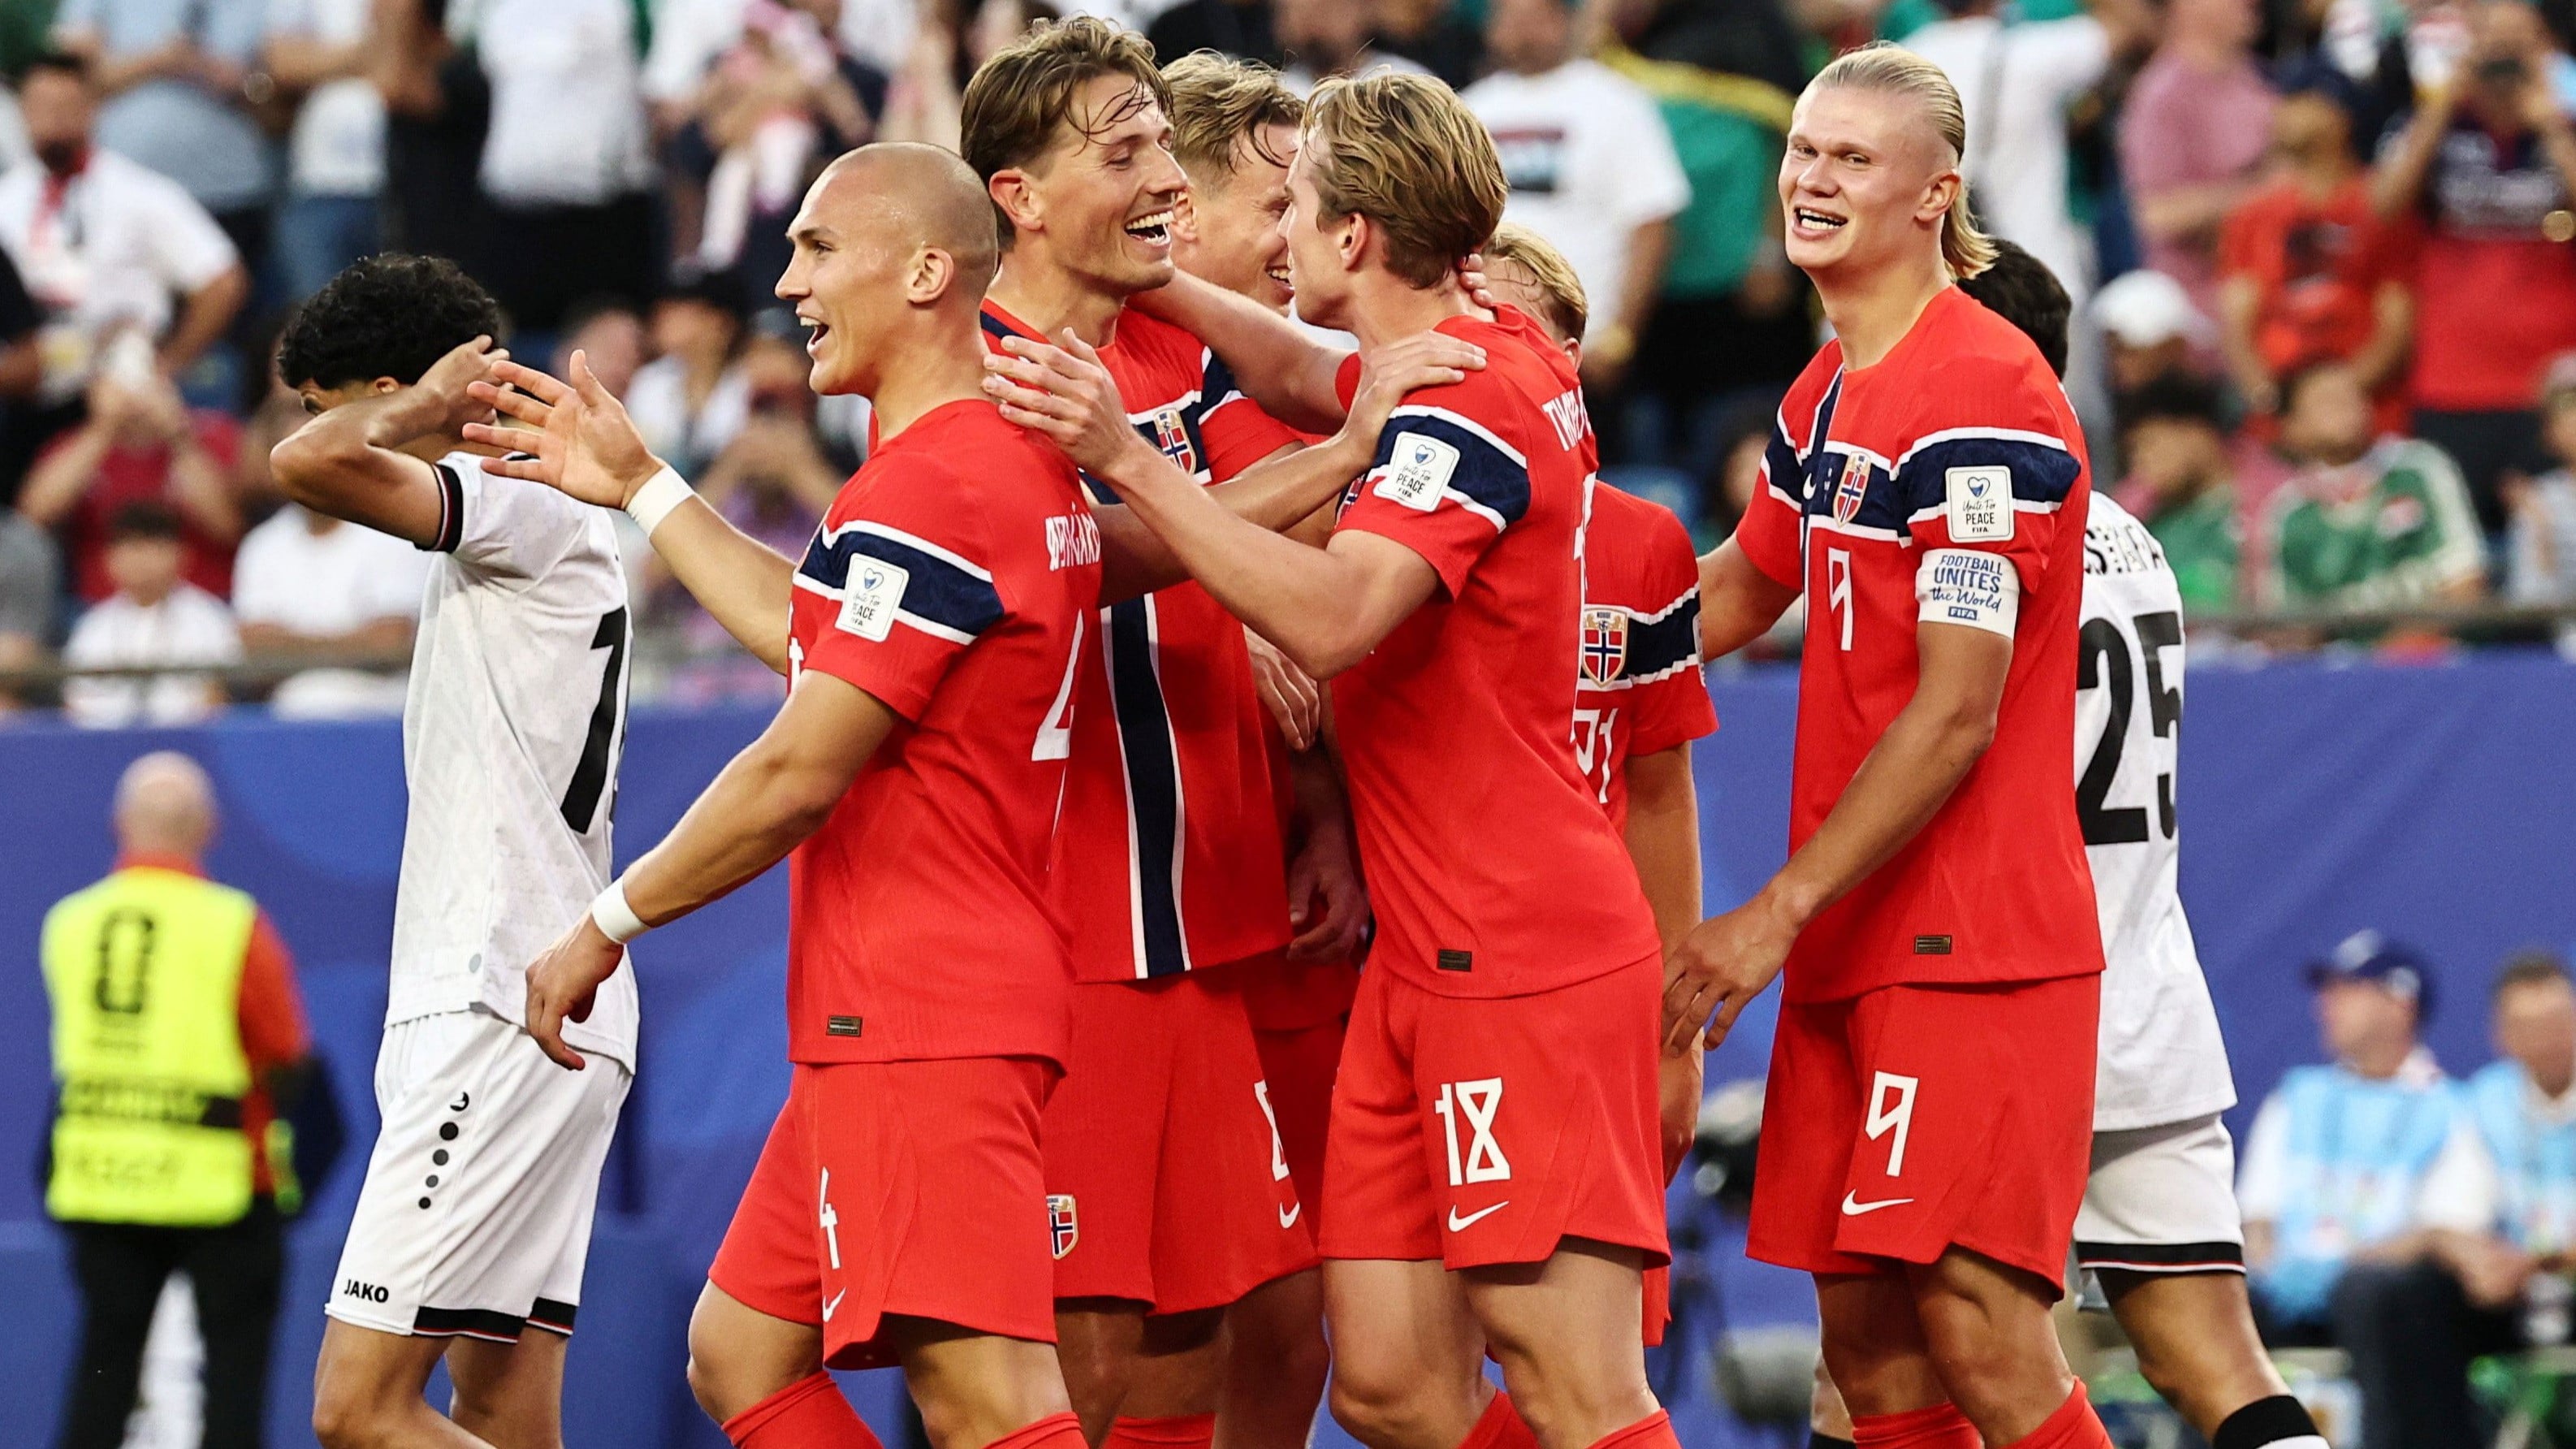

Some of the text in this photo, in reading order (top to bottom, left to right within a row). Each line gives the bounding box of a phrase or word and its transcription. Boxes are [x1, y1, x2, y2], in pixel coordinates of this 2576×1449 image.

[1396, 474, 1425, 495] PEACE
[1965, 513, 1995, 525] PEACE
[1940, 555, 2003, 576] FOOTBALL
[1934, 566, 2001, 593] UNITES
[1828, 547, 1853, 651] 9
[1930, 586, 2003, 613] the World
[1949, 607, 1977, 620] FIFA
[560, 603, 627, 834] 1
[2077, 611, 2181, 845] 25
[1435, 1077, 1511, 1186] 18
[1865, 1071, 1919, 1177] 9
[819, 1166, 841, 1269] 4
[344, 1278, 389, 1304] JAKO
